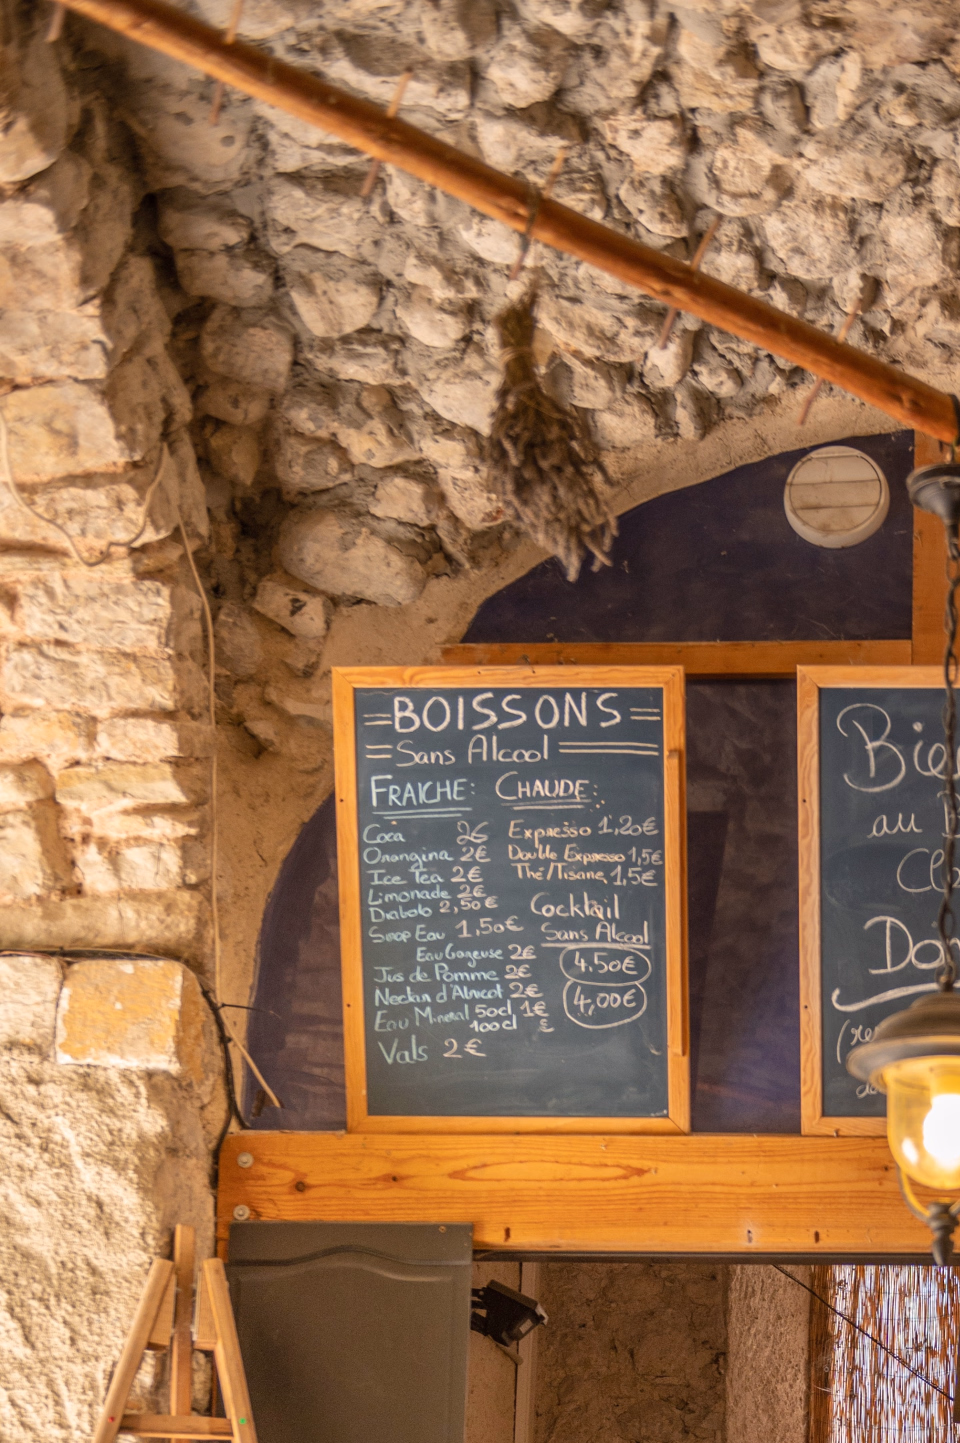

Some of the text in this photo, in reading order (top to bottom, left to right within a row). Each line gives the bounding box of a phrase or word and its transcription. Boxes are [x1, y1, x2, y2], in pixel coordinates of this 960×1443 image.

[393, 692, 621, 733] BOISSONS
[396, 734, 548, 767] Sans Alcool
[363, 824, 406, 843] Coca
[867, 812, 923, 838] au
[363, 845, 491, 871] Orangina 2€
[508, 844, 558, 861] Double
[366, 866, 483, 885] Ice Tea 2€
[368, 884, 452, 905] Limonade
[531, 892, 620, 920] Cocktail
[415, 924, 445, 942] Eau
[541, 920, 648, 944] Sans Alcool
[508, 943, 537, 960] 2€
[374, 962, 532, 983] Jus de Pomme 2€
[508, 981, 544, 998] 2€
[374, 1010, 409, 1032] Eau
[377, 1034, 428, 1065] Vals
